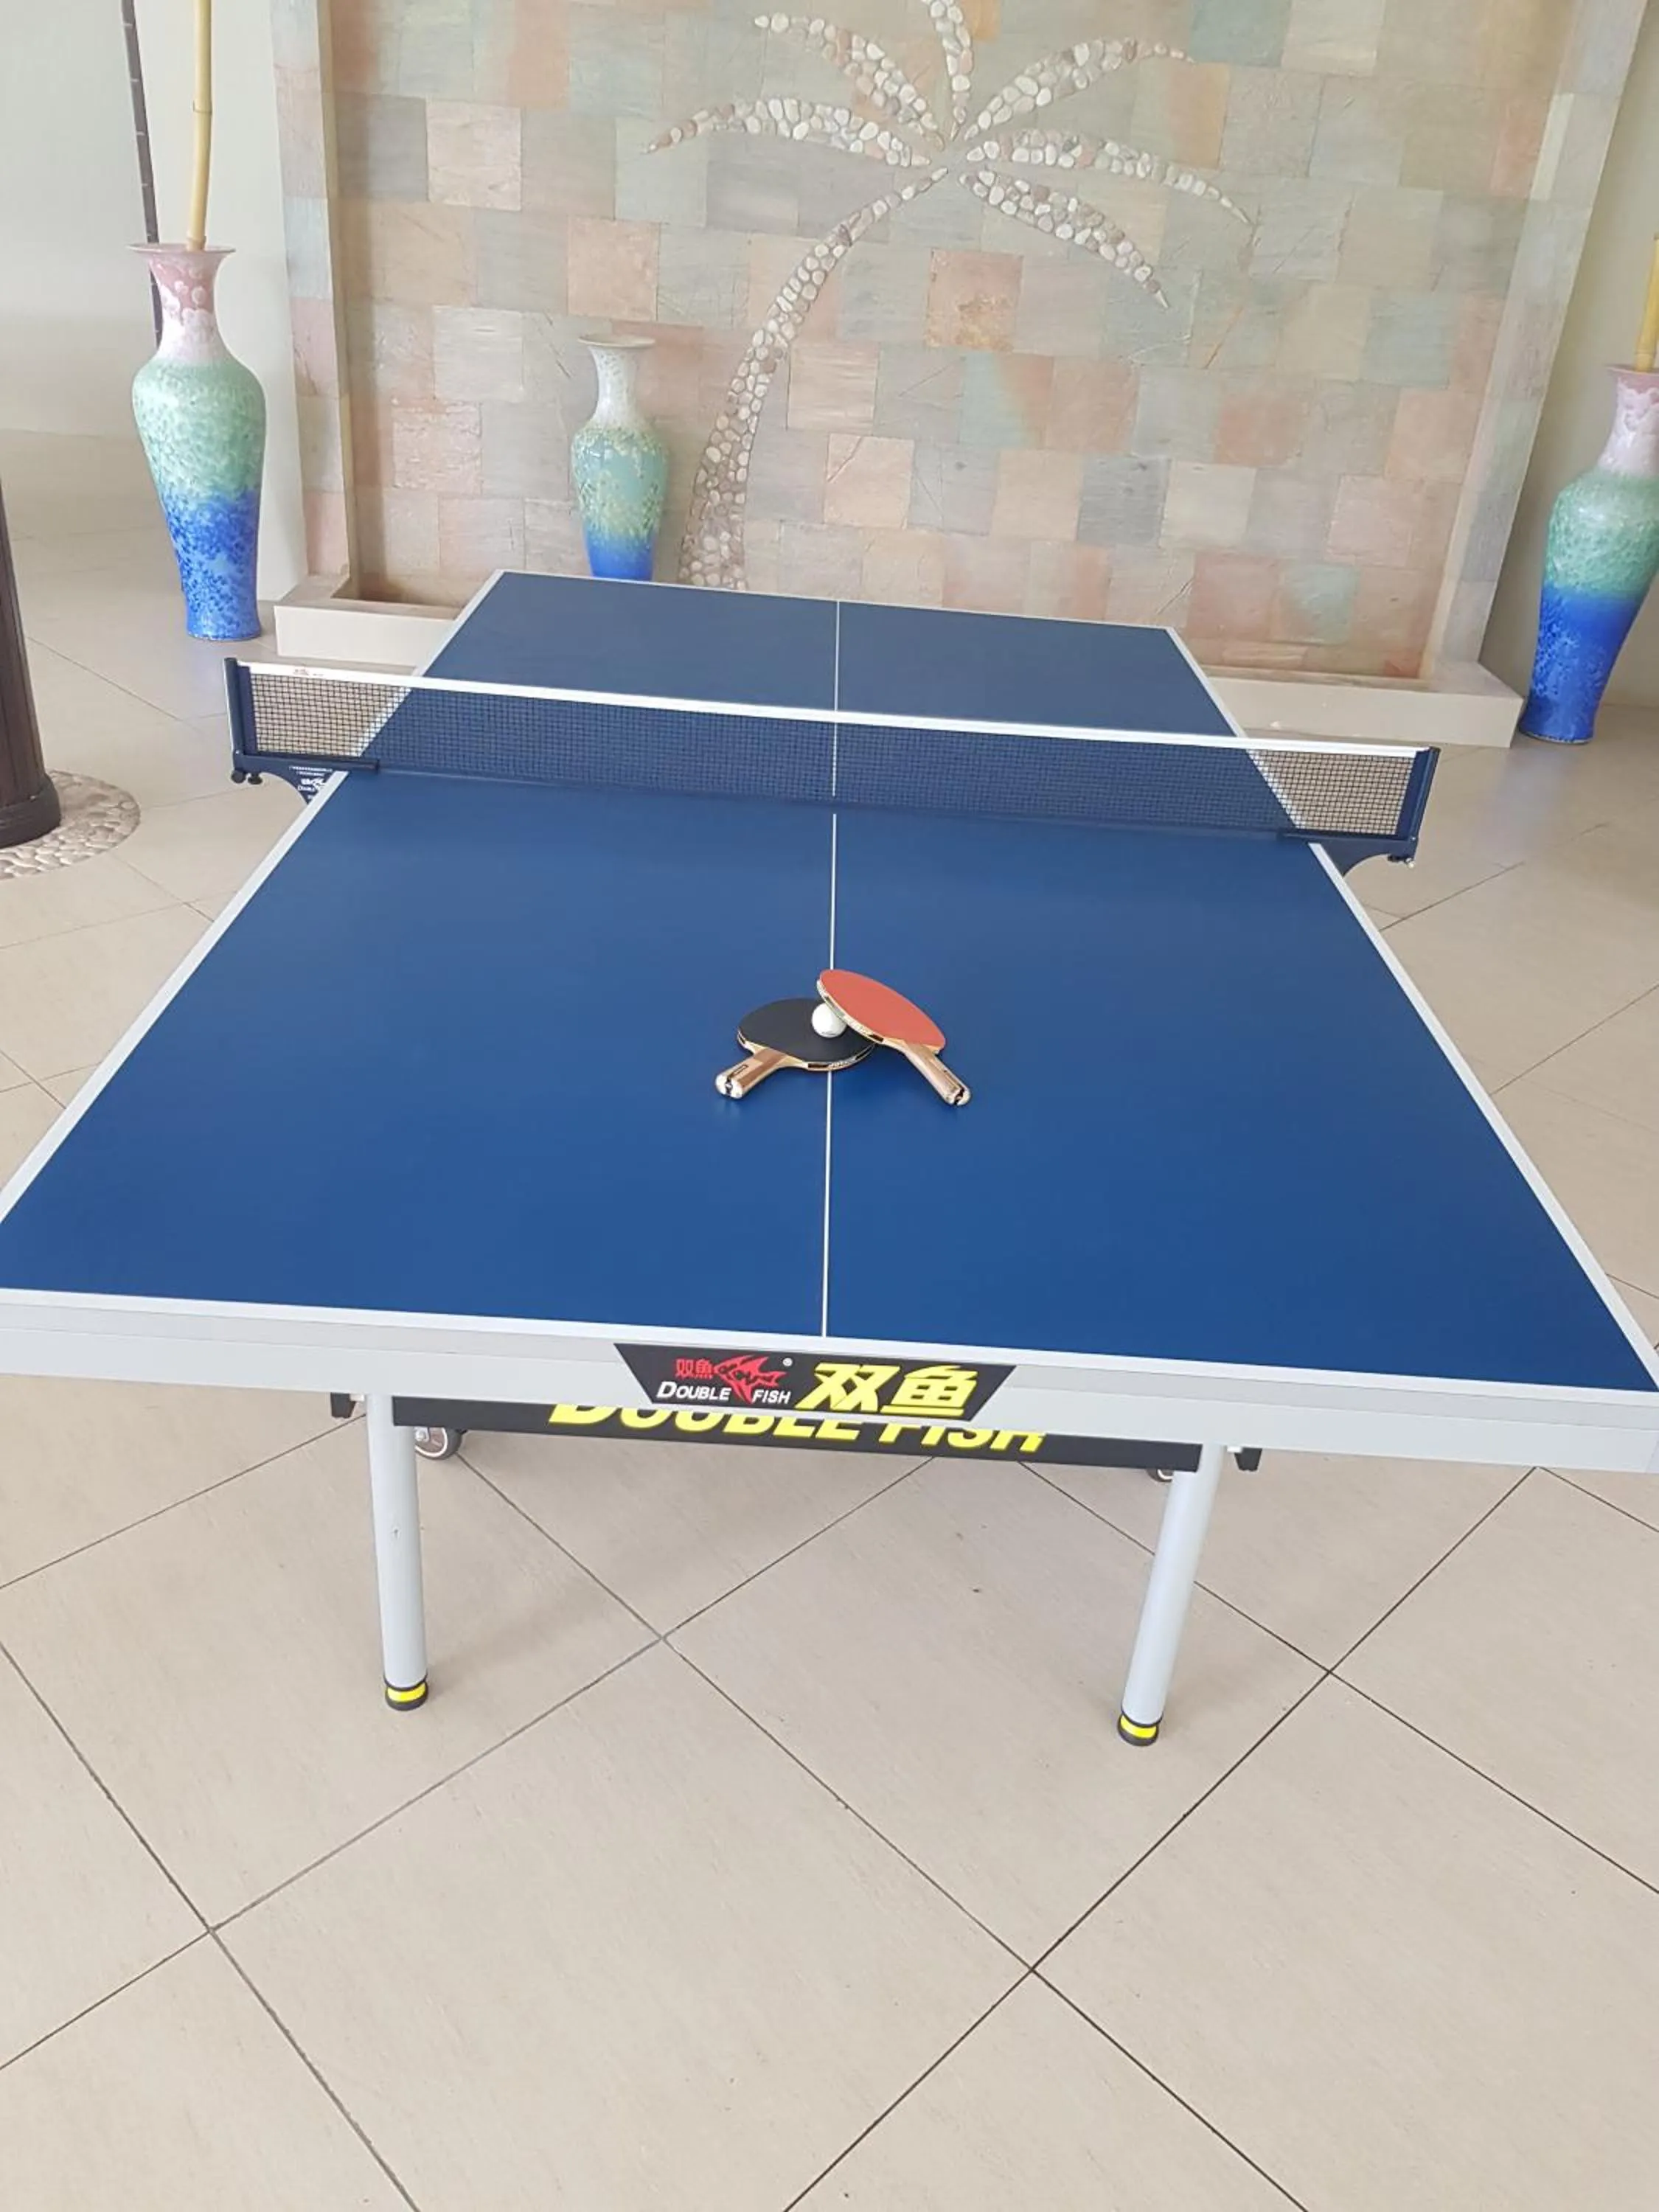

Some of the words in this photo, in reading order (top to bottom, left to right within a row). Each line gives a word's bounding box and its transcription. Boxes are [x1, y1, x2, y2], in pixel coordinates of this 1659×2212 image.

[656, 1381, 731, 1401] DOUBLE
[751, 1389, 791, 1405] FISH
[794, 1363, 978, 1416] 双鱼
